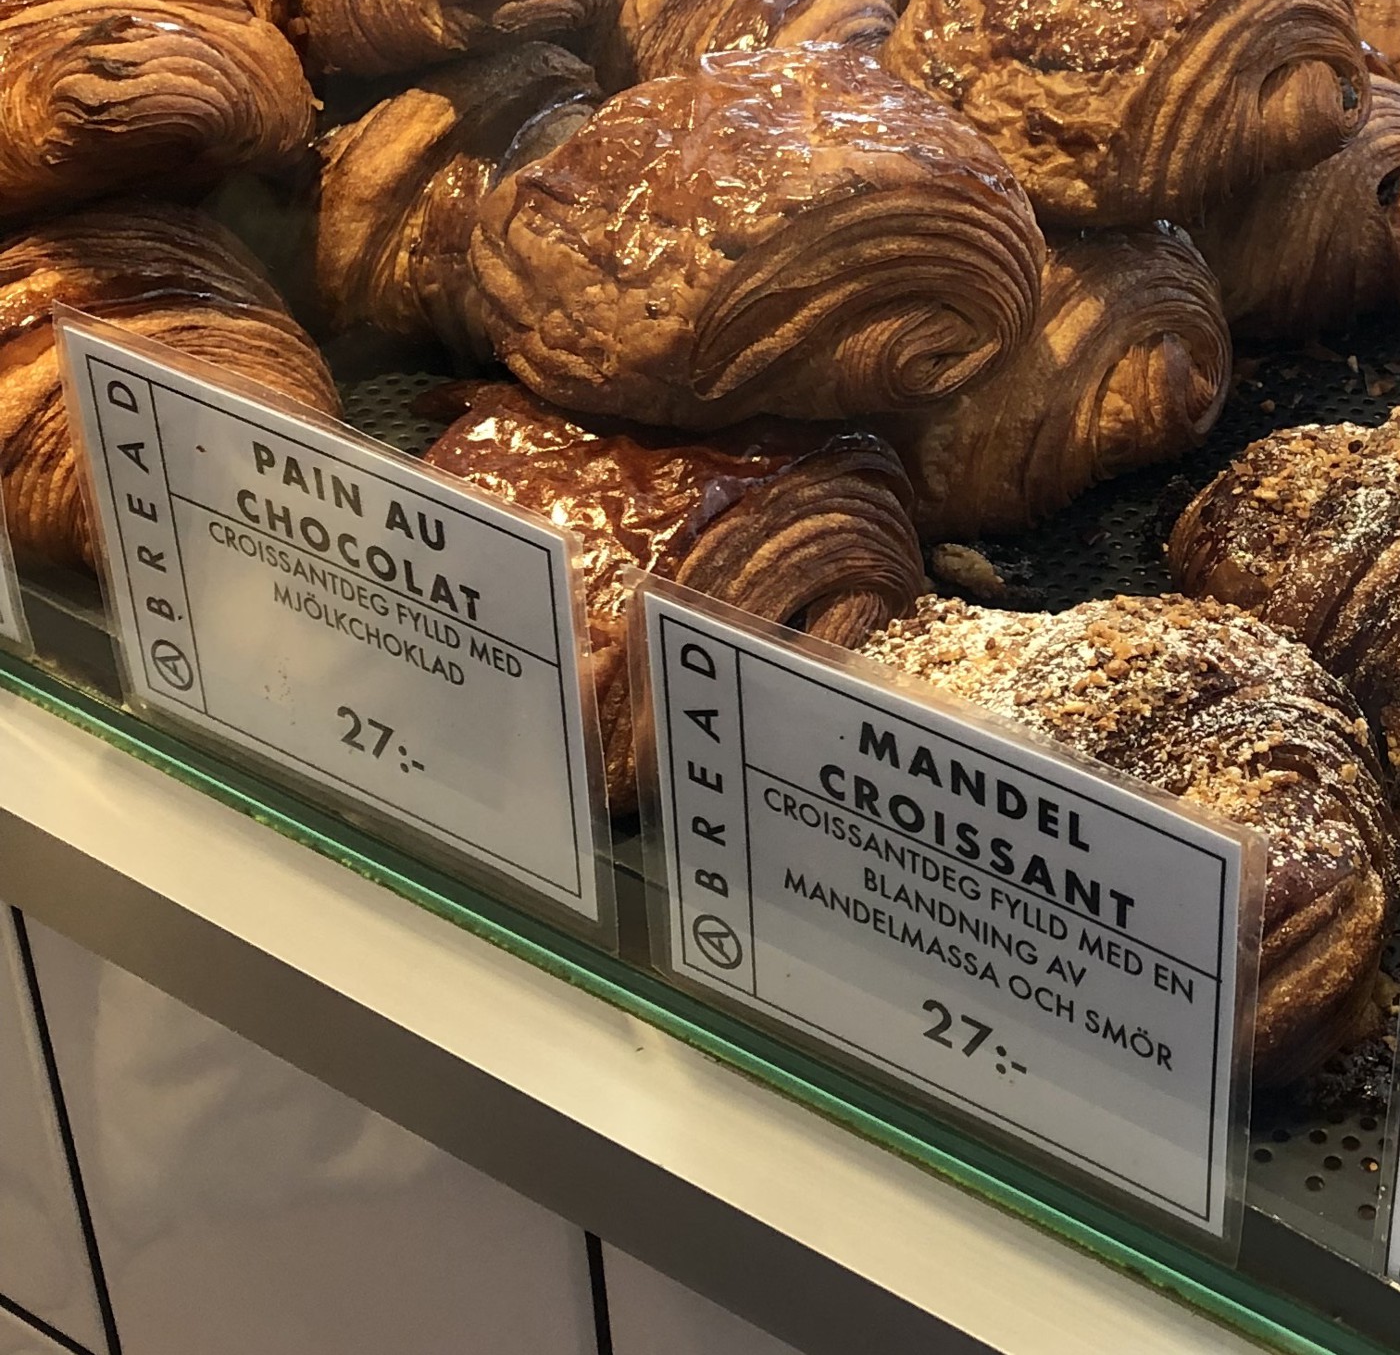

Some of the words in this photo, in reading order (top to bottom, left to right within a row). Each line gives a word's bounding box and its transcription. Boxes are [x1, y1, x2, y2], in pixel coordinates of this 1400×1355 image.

[106, 378, 178, 623] BREAD
[236, 488, 481, 622] CHOCOLAT
[252, 440, 363, 518] PAIN
[385, 513, 445, 552] AU
[208, 520, 390, 618] CROISSANTDEG
[396, 601, 461, 650] FYLLD
[467, 638, 523, 679] MED
[273, 581, 466, 687] MJÖLKCHOKLAD
[336, 705, 426, 774] 27:-
[681, 643, 730, 899] BREAD
[858, 720, 1091, 853] MANDEL
[763, 787, 981, 902] CROISSANTDEG
[990, 889, 1069, 941] FYLLD
[1077, 934, 1144, 977] MED
[1153, 964, 1195, 1004] EN
[818, 762, 1137, 931] CROISSANT
[783, 866, 1001, 990] MANDELMASSA
[1007, 975, 1076, 1025] OCH
[1084, 1015, 1174, 1072] SMÖR
[862, 867, 1039, 966] BLANDNING
[1045, 956, 1088, 988] AV
[920, 998, 1029, 1075] 27:-
